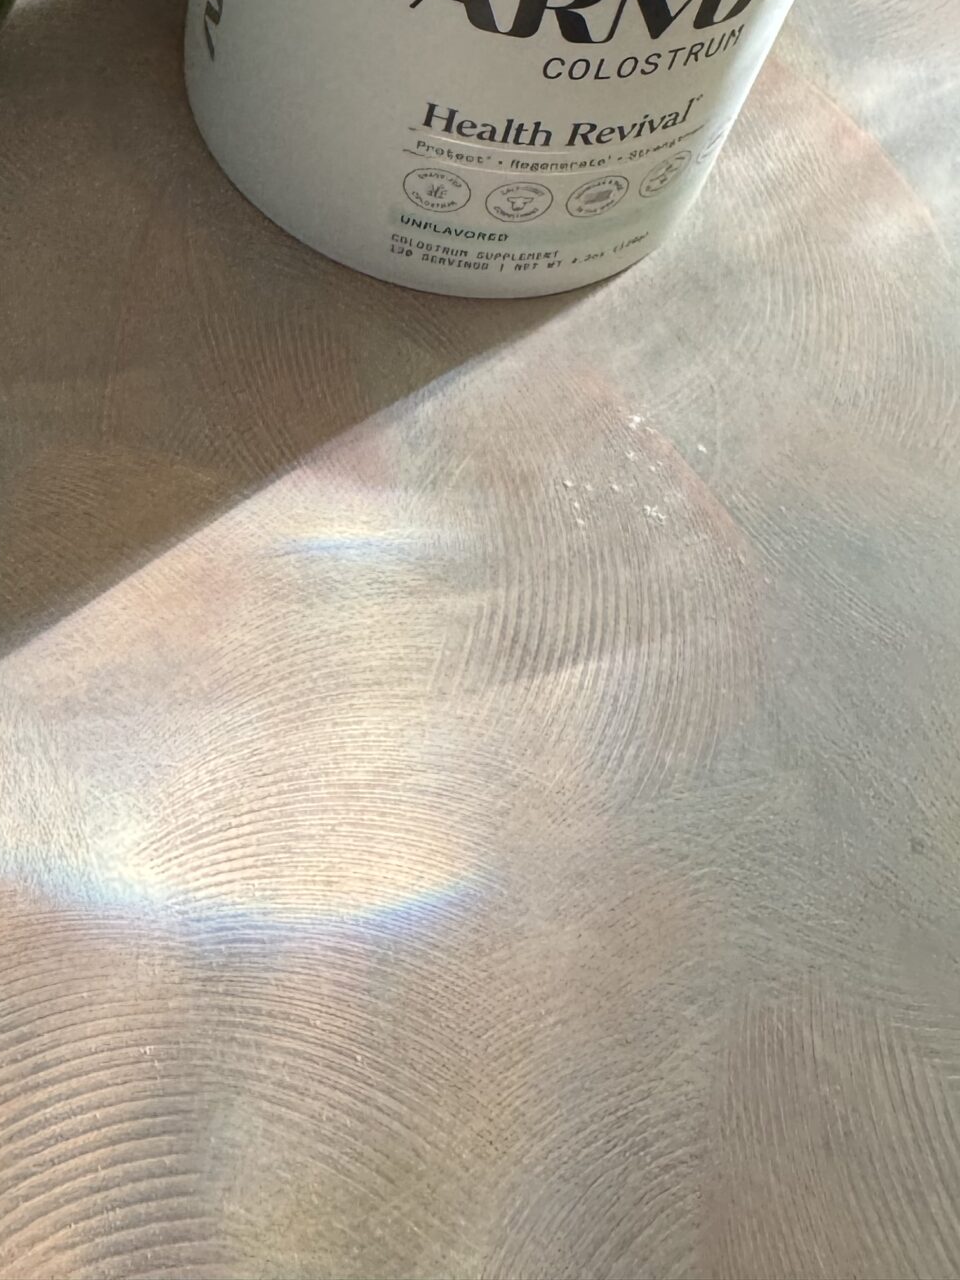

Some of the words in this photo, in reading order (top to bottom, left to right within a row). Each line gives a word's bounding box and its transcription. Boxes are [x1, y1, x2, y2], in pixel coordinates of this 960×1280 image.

[541, 23, 746, 81] COLOSTRUM
[422, 101, 553, 147] Health
[400, 214, 510, 242] UNFLAVORED
